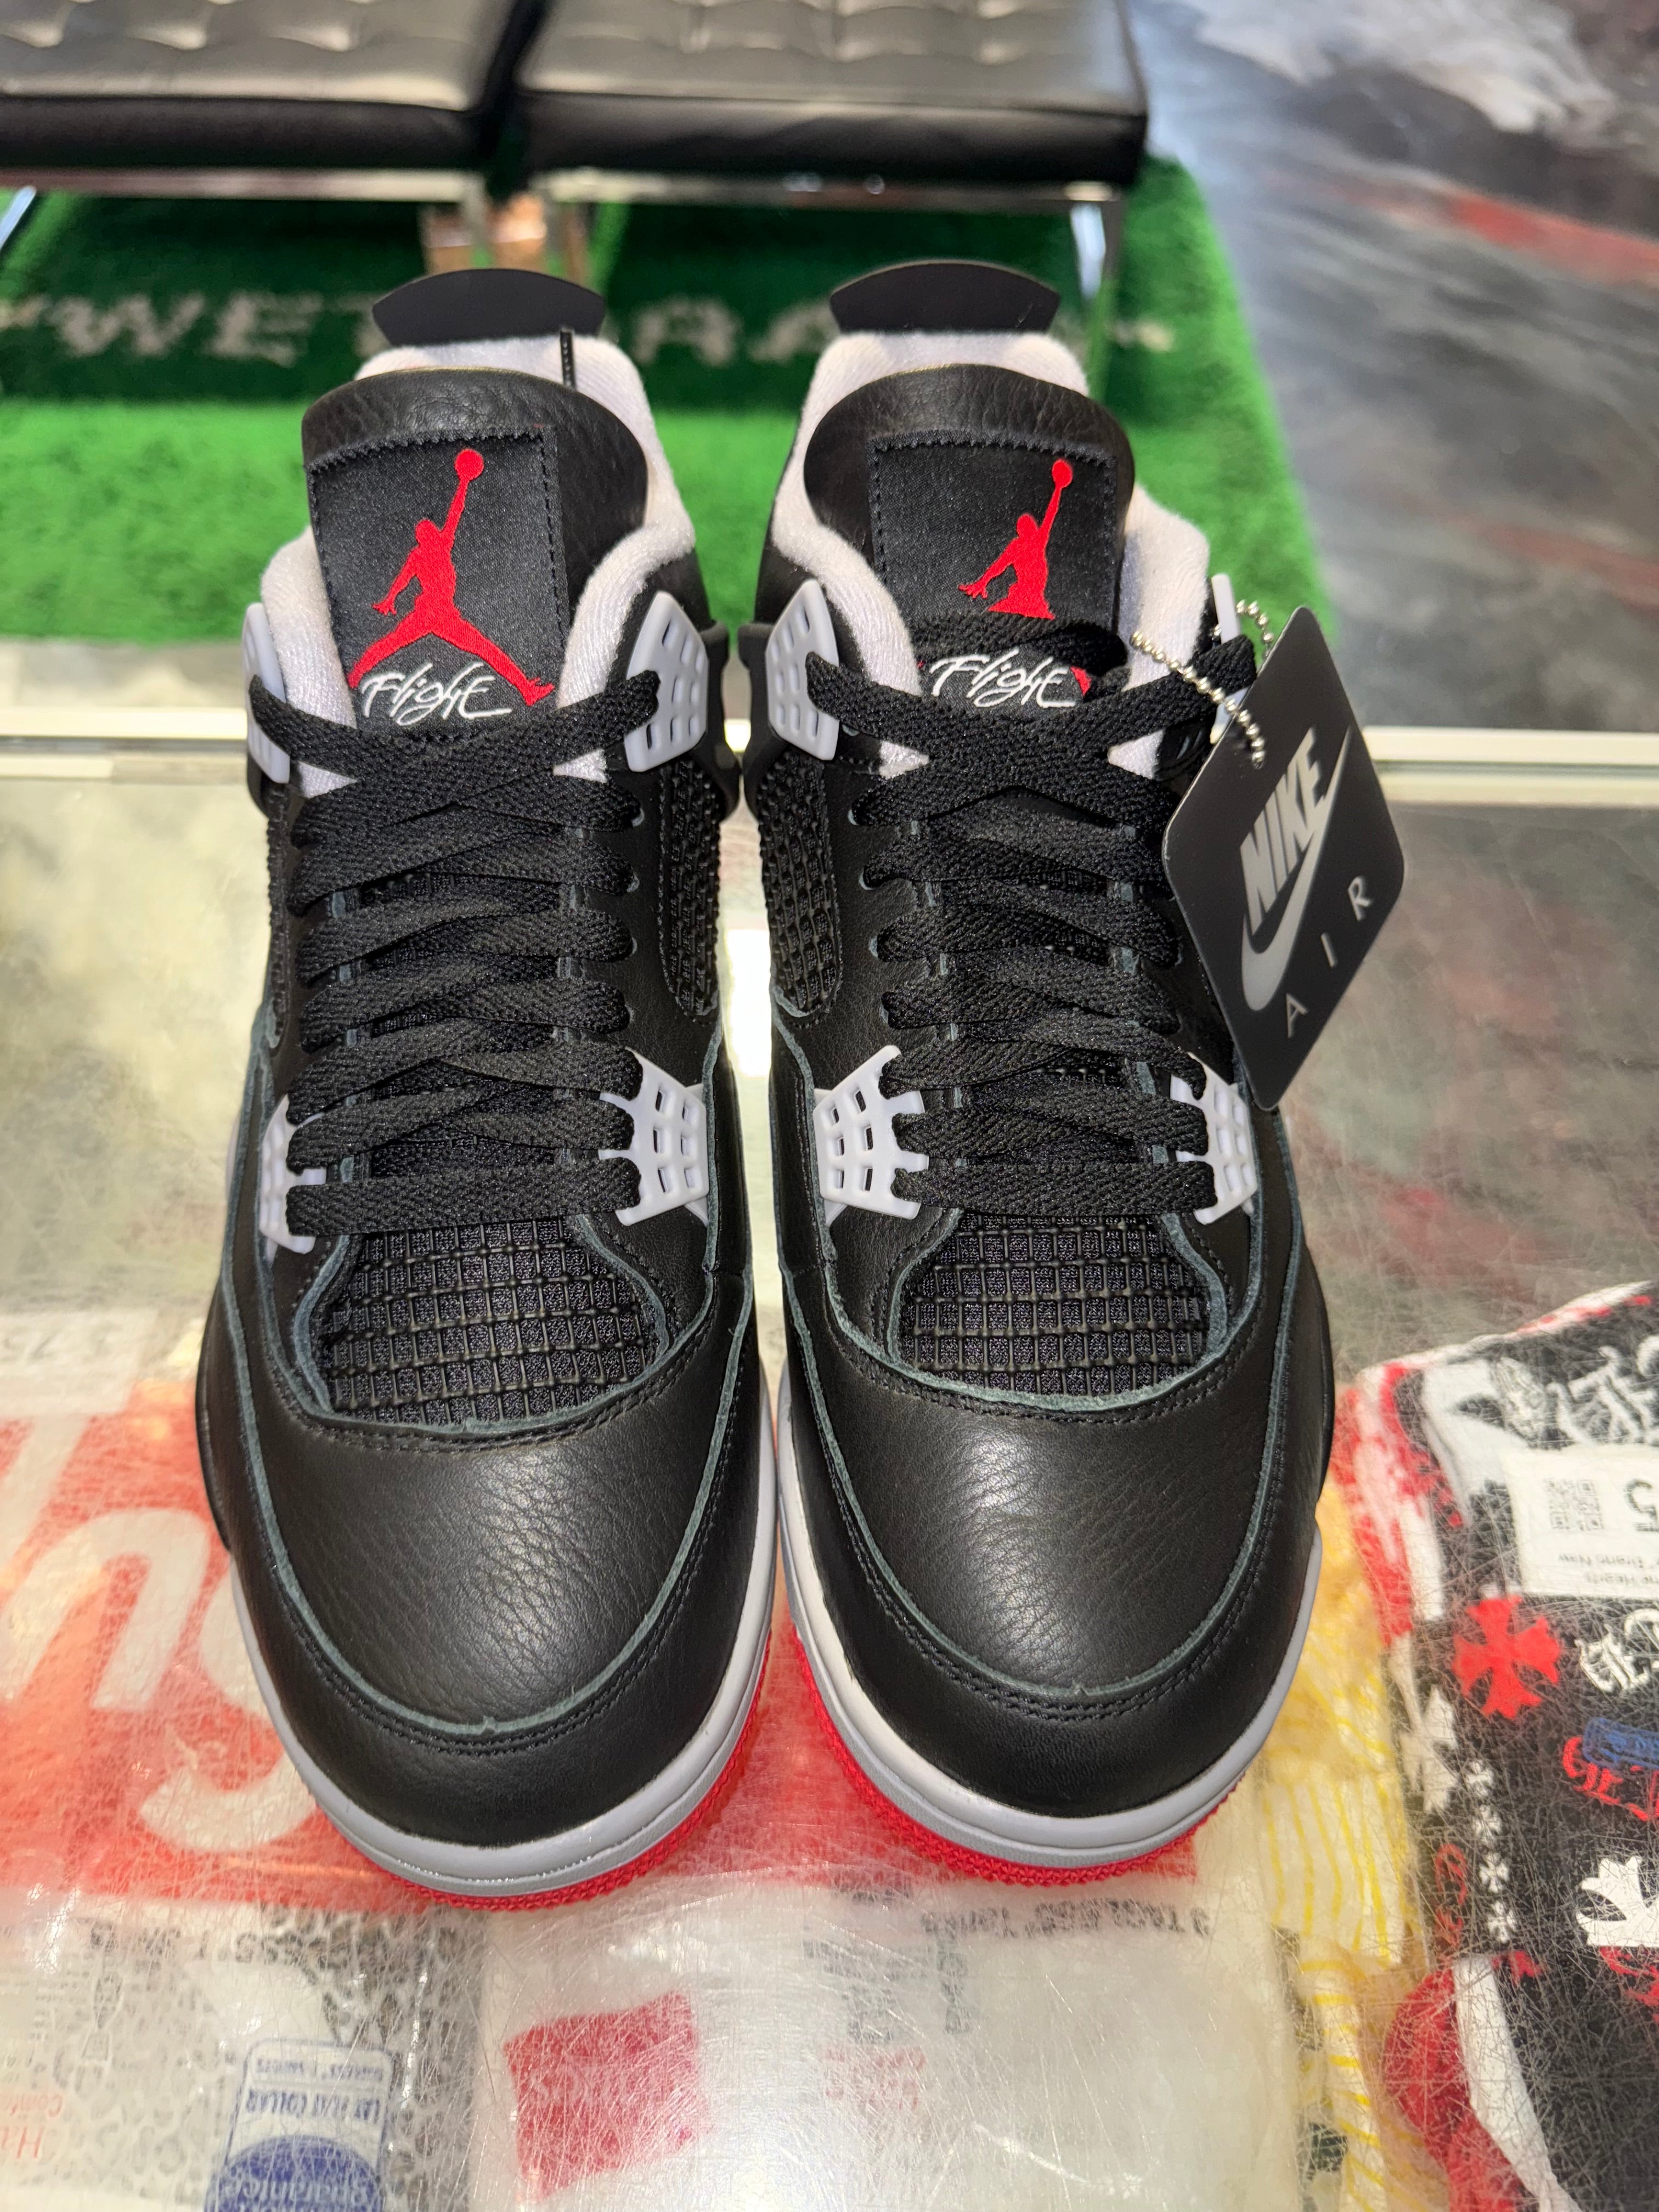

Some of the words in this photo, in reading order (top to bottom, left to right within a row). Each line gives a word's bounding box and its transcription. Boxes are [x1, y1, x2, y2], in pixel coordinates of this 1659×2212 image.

[360, 662, 512, 727] Flight
[930, 646, 1076, 709] Flight
[1239, 725, 1327, 938] NIKE
[1285, 874, 1373, 1040] AIR
